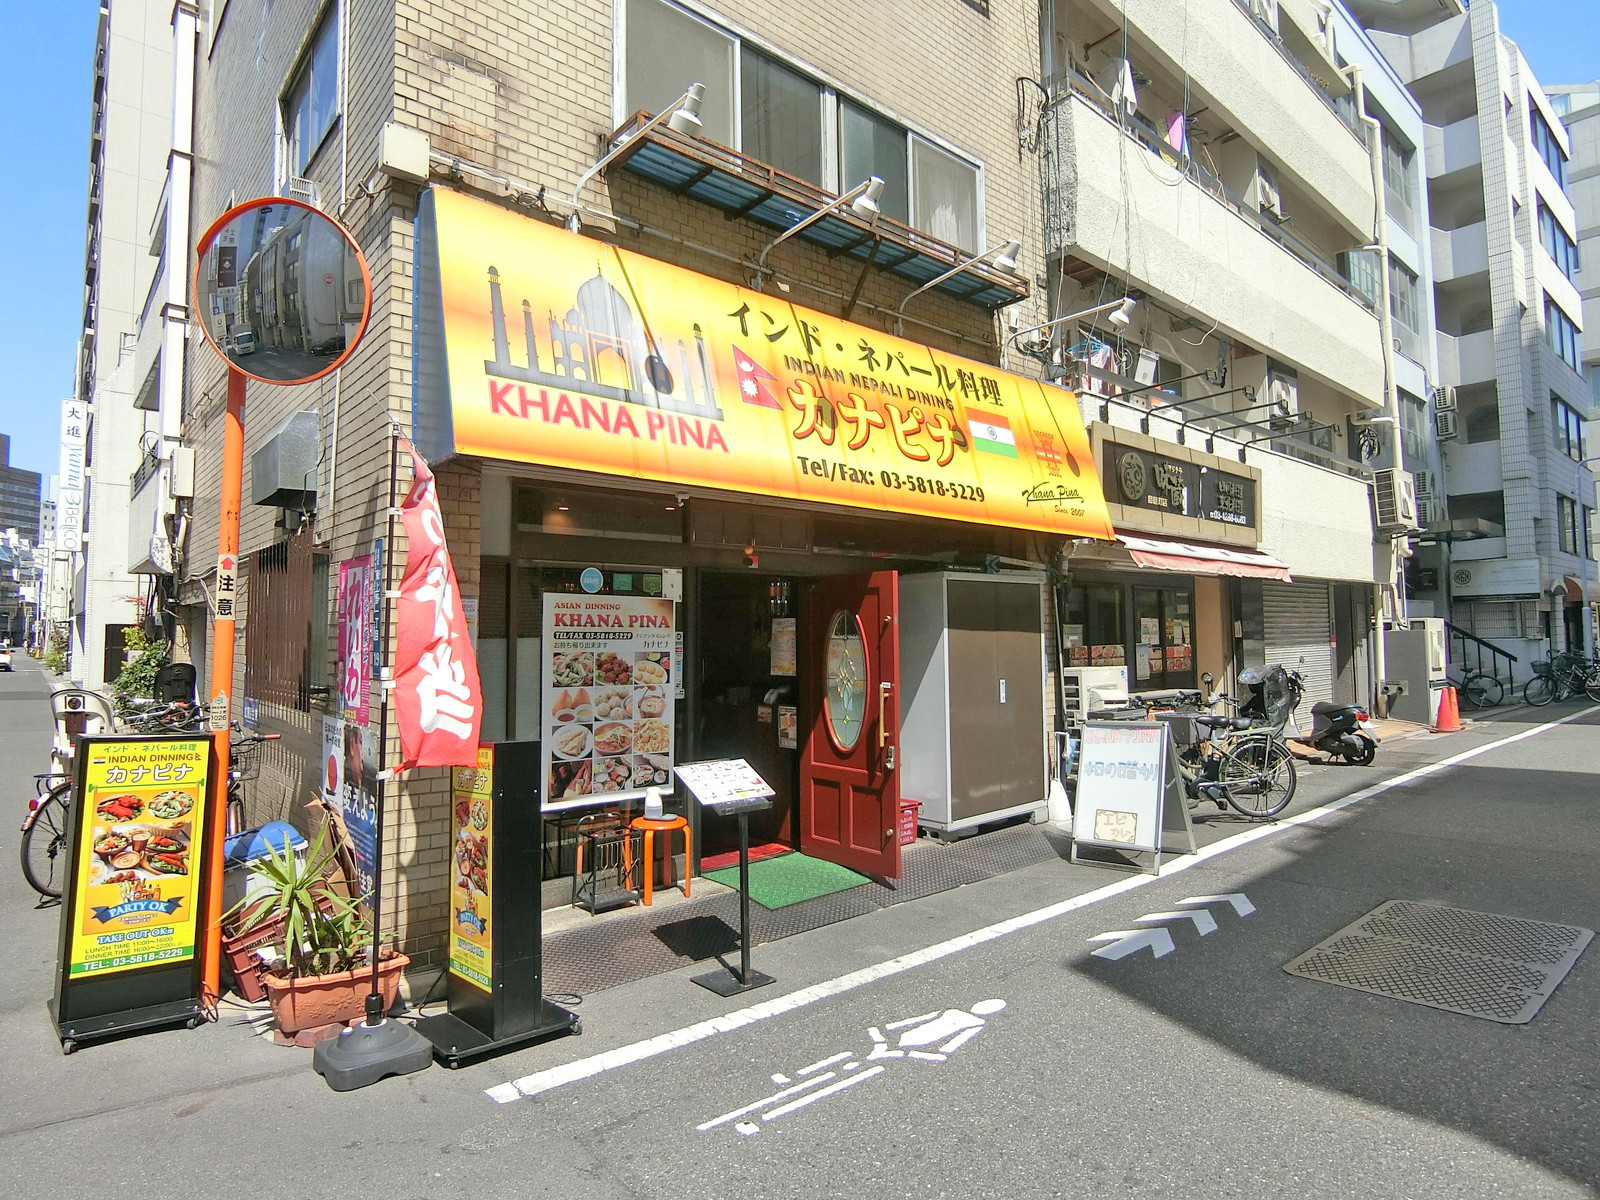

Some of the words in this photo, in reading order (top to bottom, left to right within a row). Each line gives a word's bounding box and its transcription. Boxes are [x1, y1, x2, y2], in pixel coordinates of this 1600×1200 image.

[728, 302, 1004, 407] インド・ネパール料理
[784, 354, 845, 384] INDIAN
[849, 372, 902, 399] NEPALI
[908, 386, 954, 411] DINING
[65, 406, 82, 438] 大進
[489, 379, 641, 439] KHANA
[646, 409, 729, 454] PINA
[787, 379, 968, 467] カナピナ
[797, 455, 875, 486] Tel/Fax:
[880, 469, 985, 503] 03-5818-5229
[1070, 507, 1085, 517] 2007
[216, 574, 234, 616] 注意
[553, 613, 624, 628] KHANA
[628, 615, 671, 629] PINA
[1084, 729, 1121, 744] KHANA
[108, 755, 146, 763] INDIAN
[149, 754, 193, 762] DINNING
[106, 763, 193, 783] カナピナ
[458, 771, 488, 791] カナピナ
[109, 902, 147, 918] PARTY
[149, 901, 169, 912] OK
[97, 934, 124, 945] TAKE
[126, 929, 149, 940] OUT
[83, 961, 109, 971] TEL:
[113, 949, 183, 966] 03-5818-5229
[85, 946, 112, 954] LUNCH
[85, 952, 113, 960] DINNER
